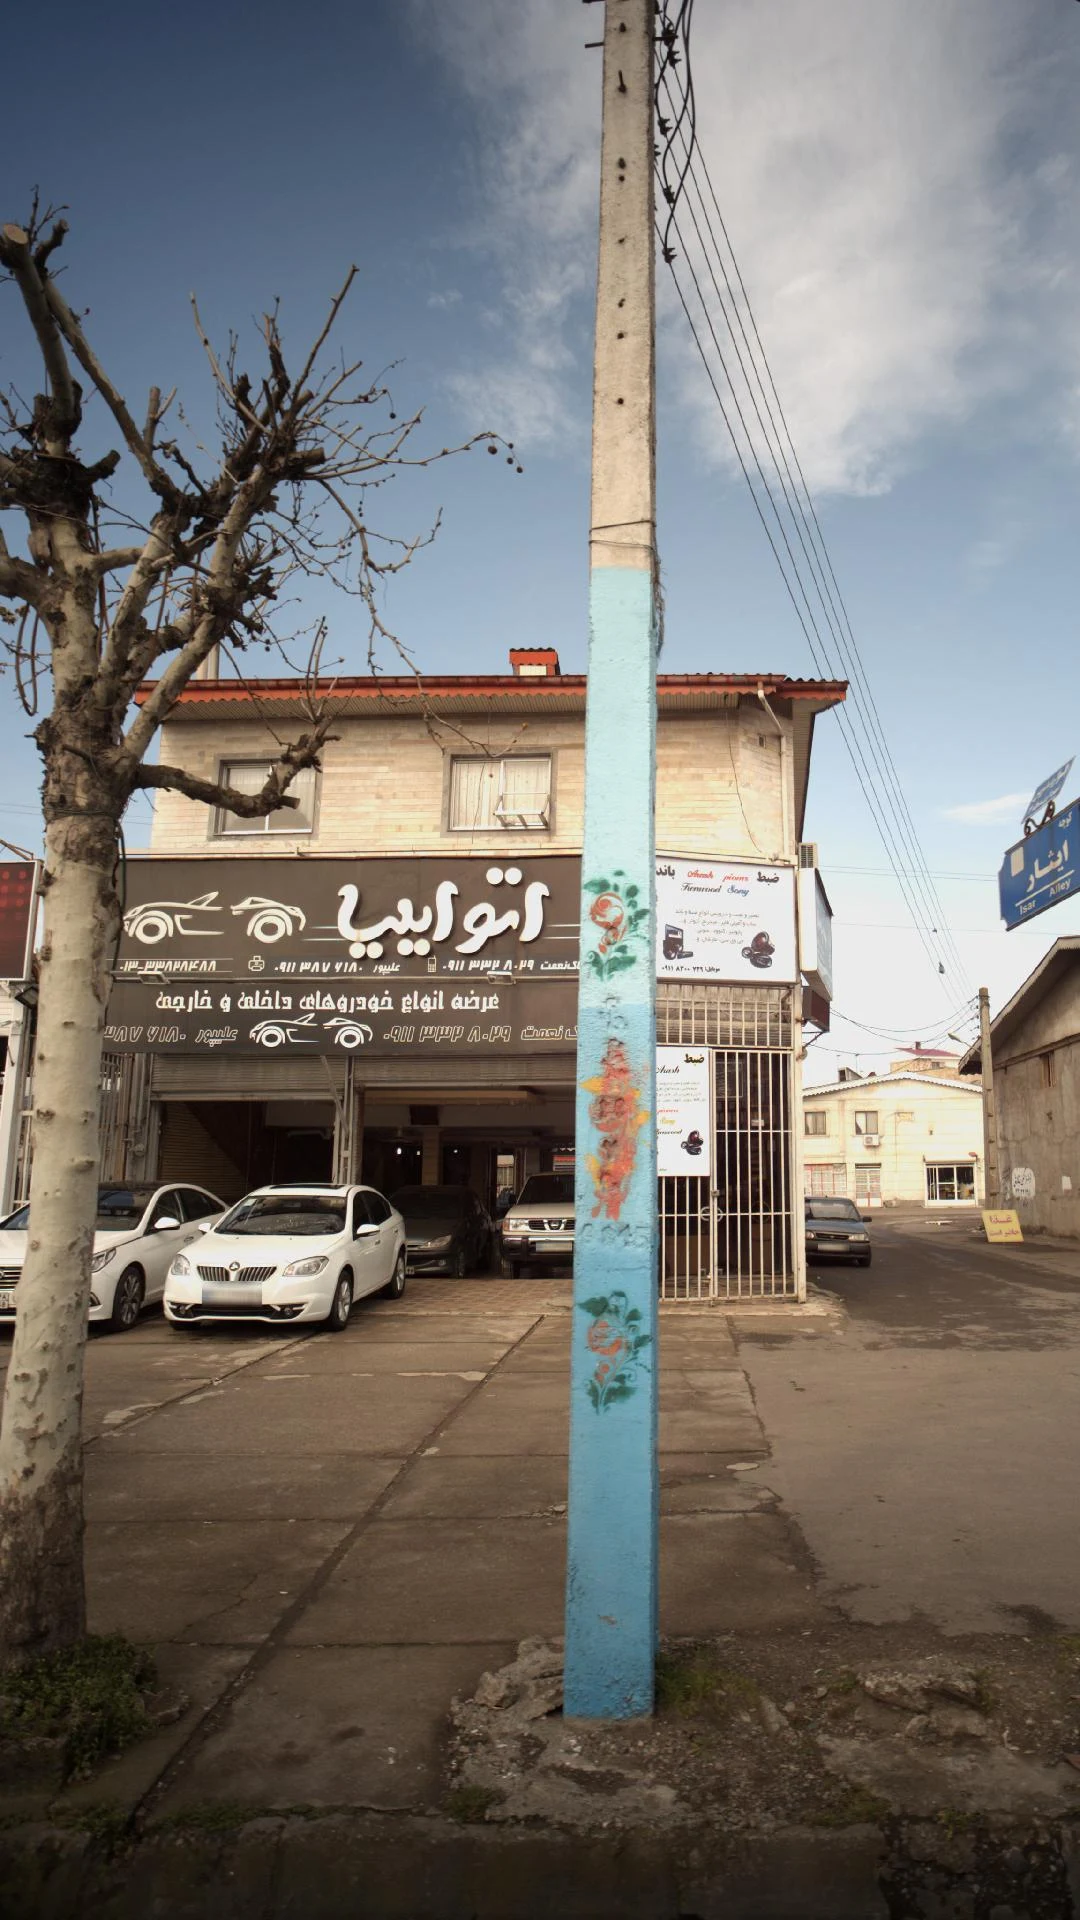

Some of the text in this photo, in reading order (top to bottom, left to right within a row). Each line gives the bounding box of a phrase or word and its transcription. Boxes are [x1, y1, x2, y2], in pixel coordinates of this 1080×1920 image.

[1027, 840, 1069, 893] ایثار
[757, 871, 780, 885] ضبط
[727, 884, 750, 897] Sony
[1019, 878, 1071, 915] Isar Alley
[274, 961, 296, 973] ۰۹۱۱
[299, 961, 331, 973] ۳۸۷
[334, 961, 363, 973] ۶۱۸۰
[442, 959, 466, 971] ۰۹۱۱
[468, 960, 501, 972] ۳۳۲
[503, 960, 535, 972] ۸۰۲۹
[156, 989, 500, 1014] عرضه انواع خودروهای داخلی و خارجی
[147, 1025, 187, 1043] ۶۱۸۰
[383, 1025, 416, 1043] ۰۹۱۱
[419, 1025, 465, 1043] ۳۳۲
[467, 1025, 512, 1043] ۸۰۲۹
[684, 1053, 705, 1067] ضبط
